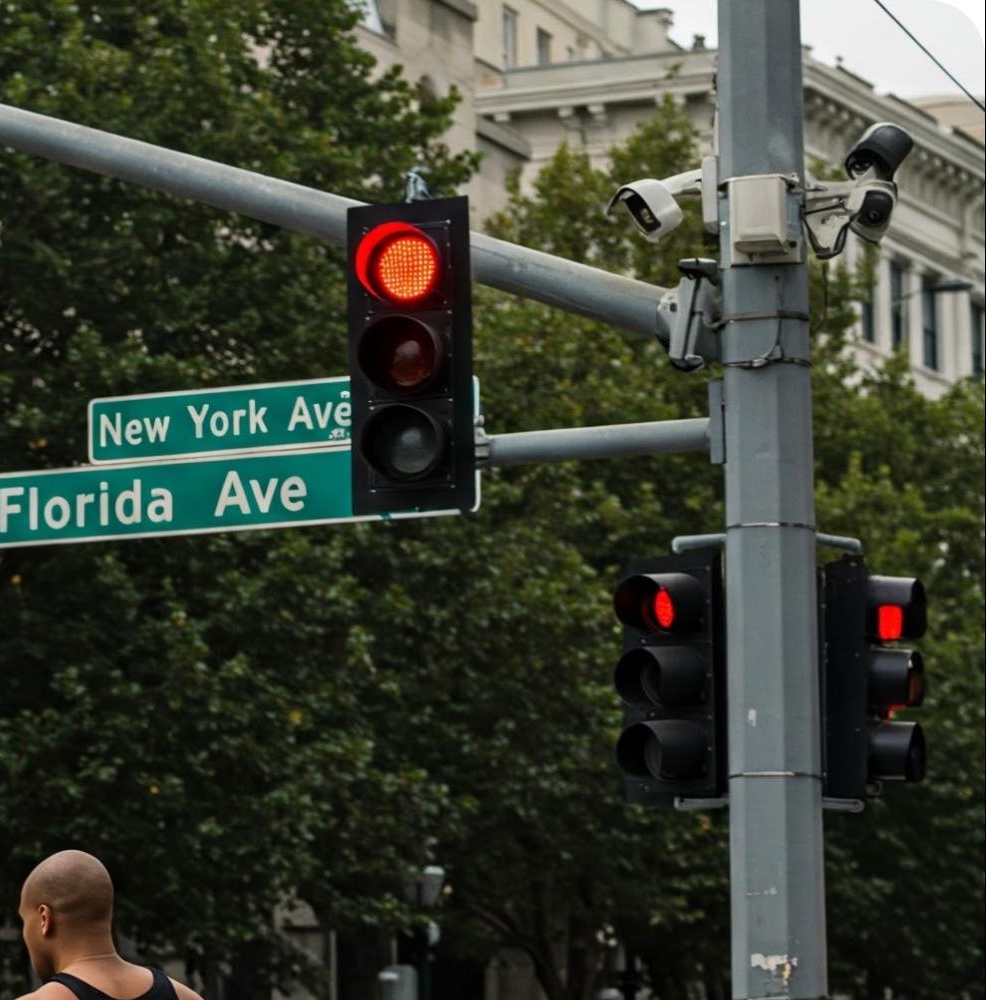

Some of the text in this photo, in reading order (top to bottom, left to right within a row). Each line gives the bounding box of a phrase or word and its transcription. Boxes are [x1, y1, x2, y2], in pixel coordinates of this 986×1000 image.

[100, 396, 352, 447] New York Ave
[0, 470, 308, 533] Florida Ave
